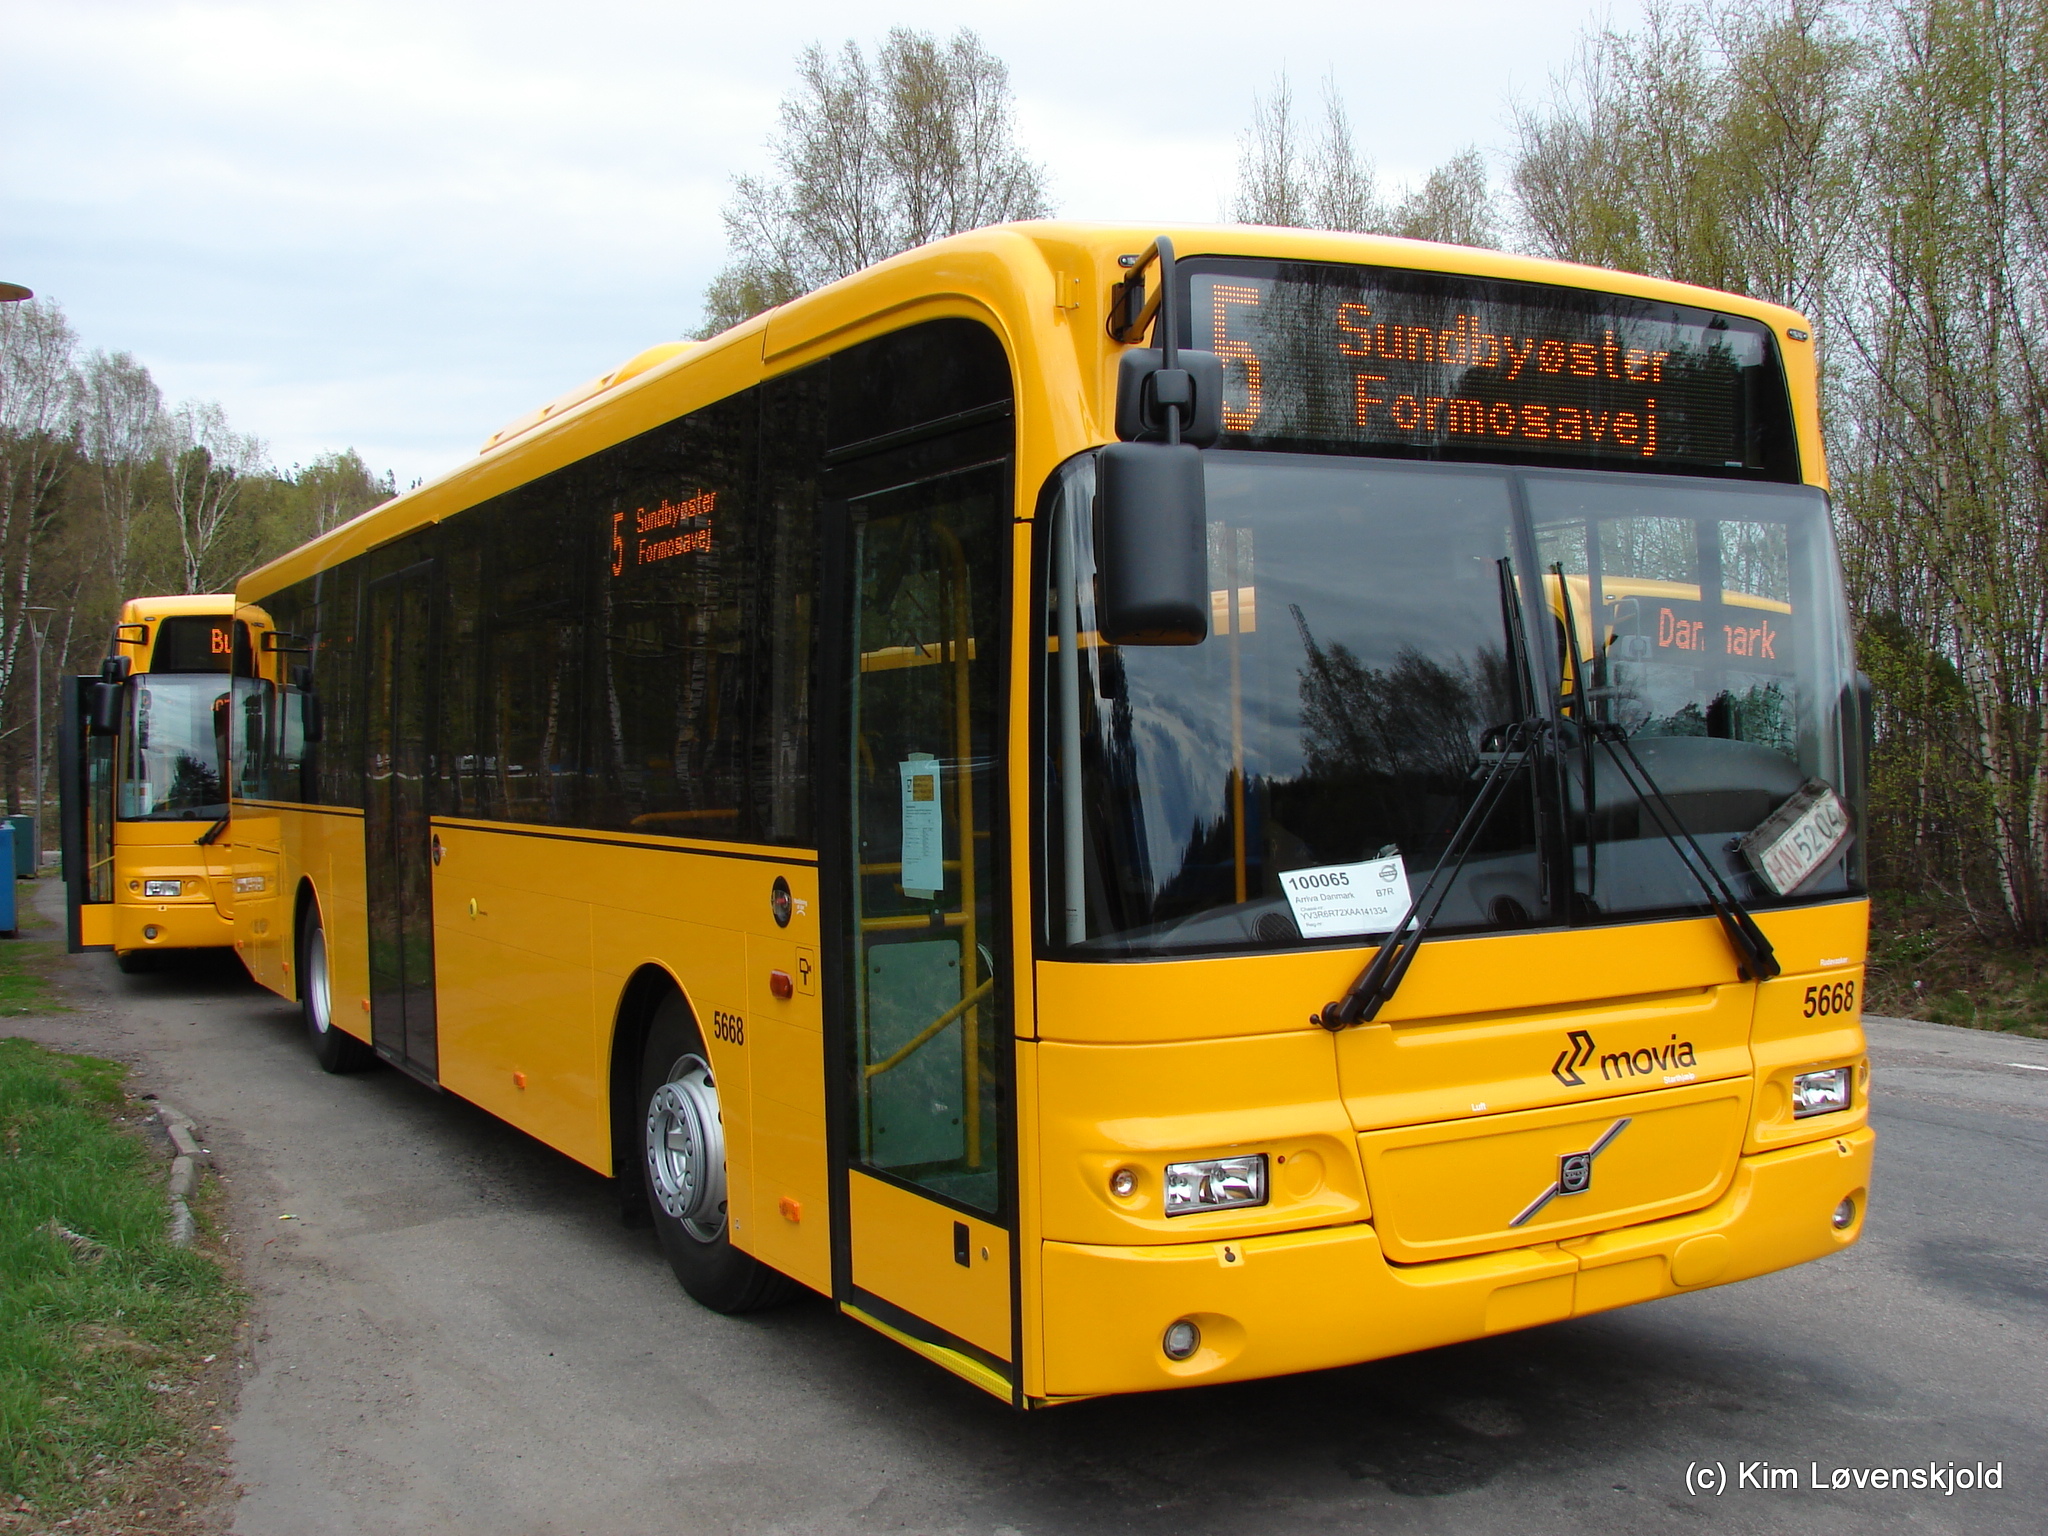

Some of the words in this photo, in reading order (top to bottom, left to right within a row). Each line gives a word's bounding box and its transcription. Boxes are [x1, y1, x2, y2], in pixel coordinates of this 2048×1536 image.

[1212, 284, 1262, 432] 5
[1338, 302, 1669, 383] Sundbyøster
[1355, 373, 1657, 457] Formosavej
[612, 512, 624, 576] 5
[638, 519, 712, 565] Formosavej
[1288, 872, 1350, 890] 100065
[1295, 895, 1319, 904] Arriva
[1319, 892, 1355, 902] Danmark
[1375, 887, 1394, 897] B7R
[1803, 980, 1855, 1019] 5668
[714, 1010, 744, 1046] 5668
[1601, 1033, 1697, 1080] movia
[1470, 1102, 1487, 1112] Luft
